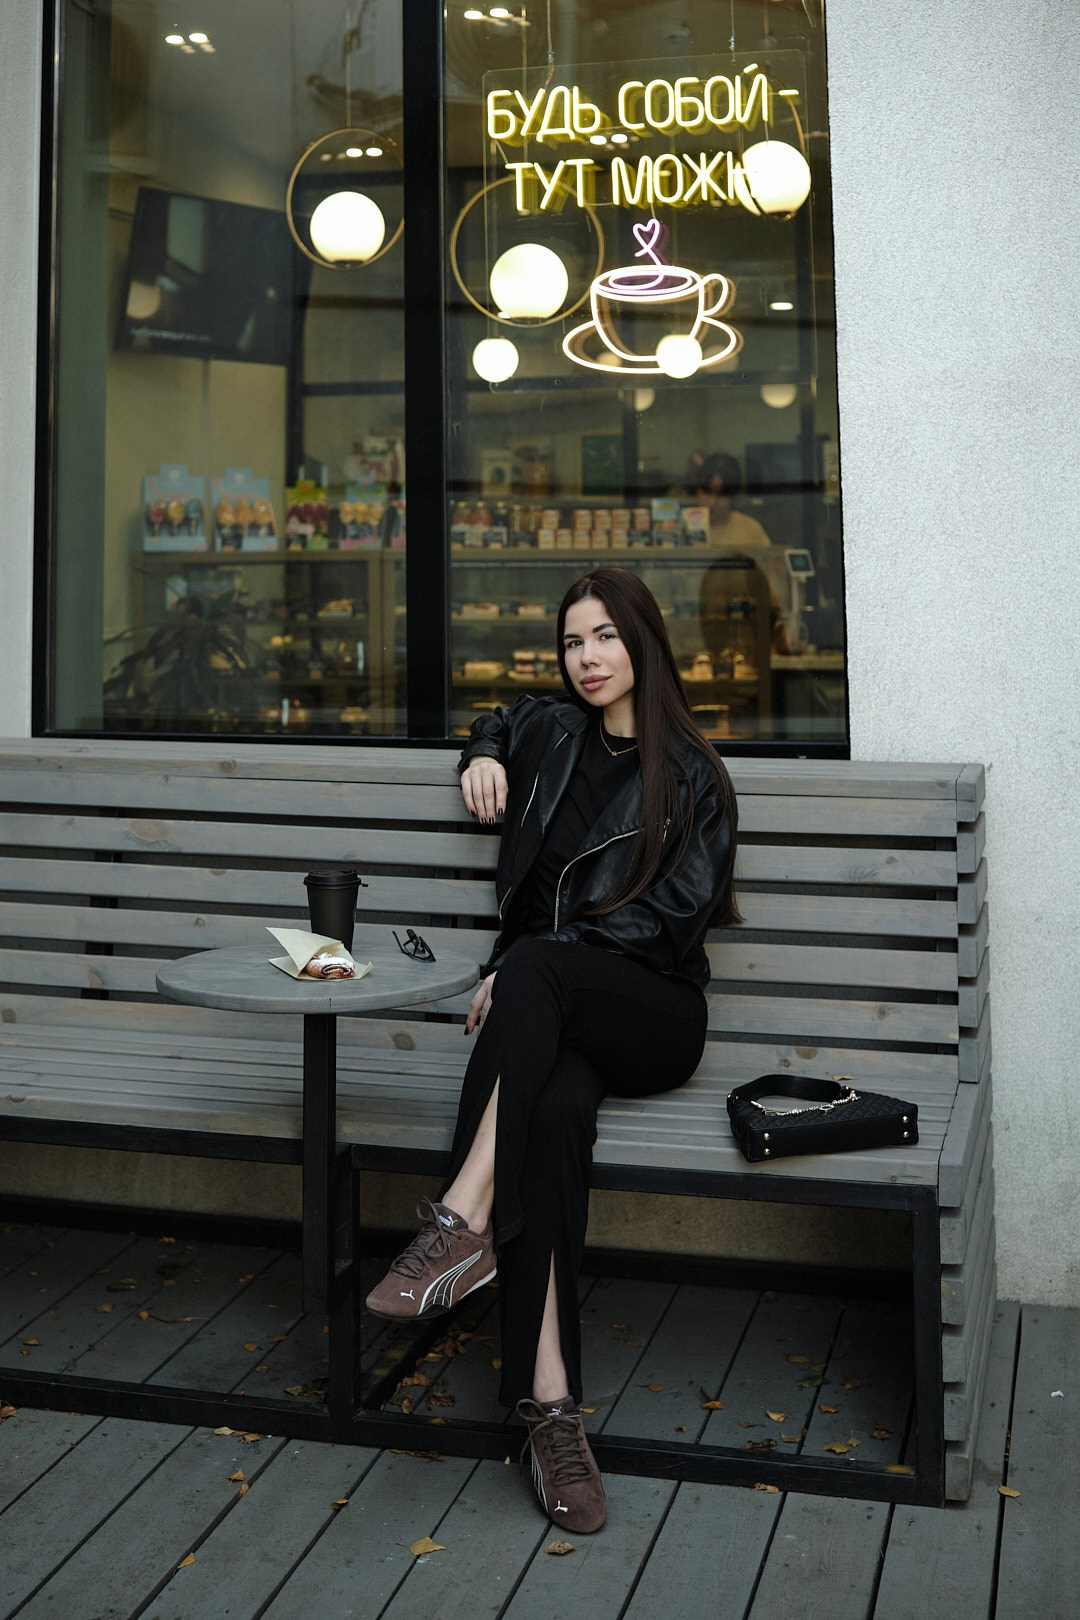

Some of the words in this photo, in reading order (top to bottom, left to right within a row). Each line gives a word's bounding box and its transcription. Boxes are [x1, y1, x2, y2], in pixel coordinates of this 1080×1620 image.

[486, 85, 602, 143] БУДЬ
[617, 62, 770, 130] СОБОЙ
[504, 157, 595, 212] ТУТ
